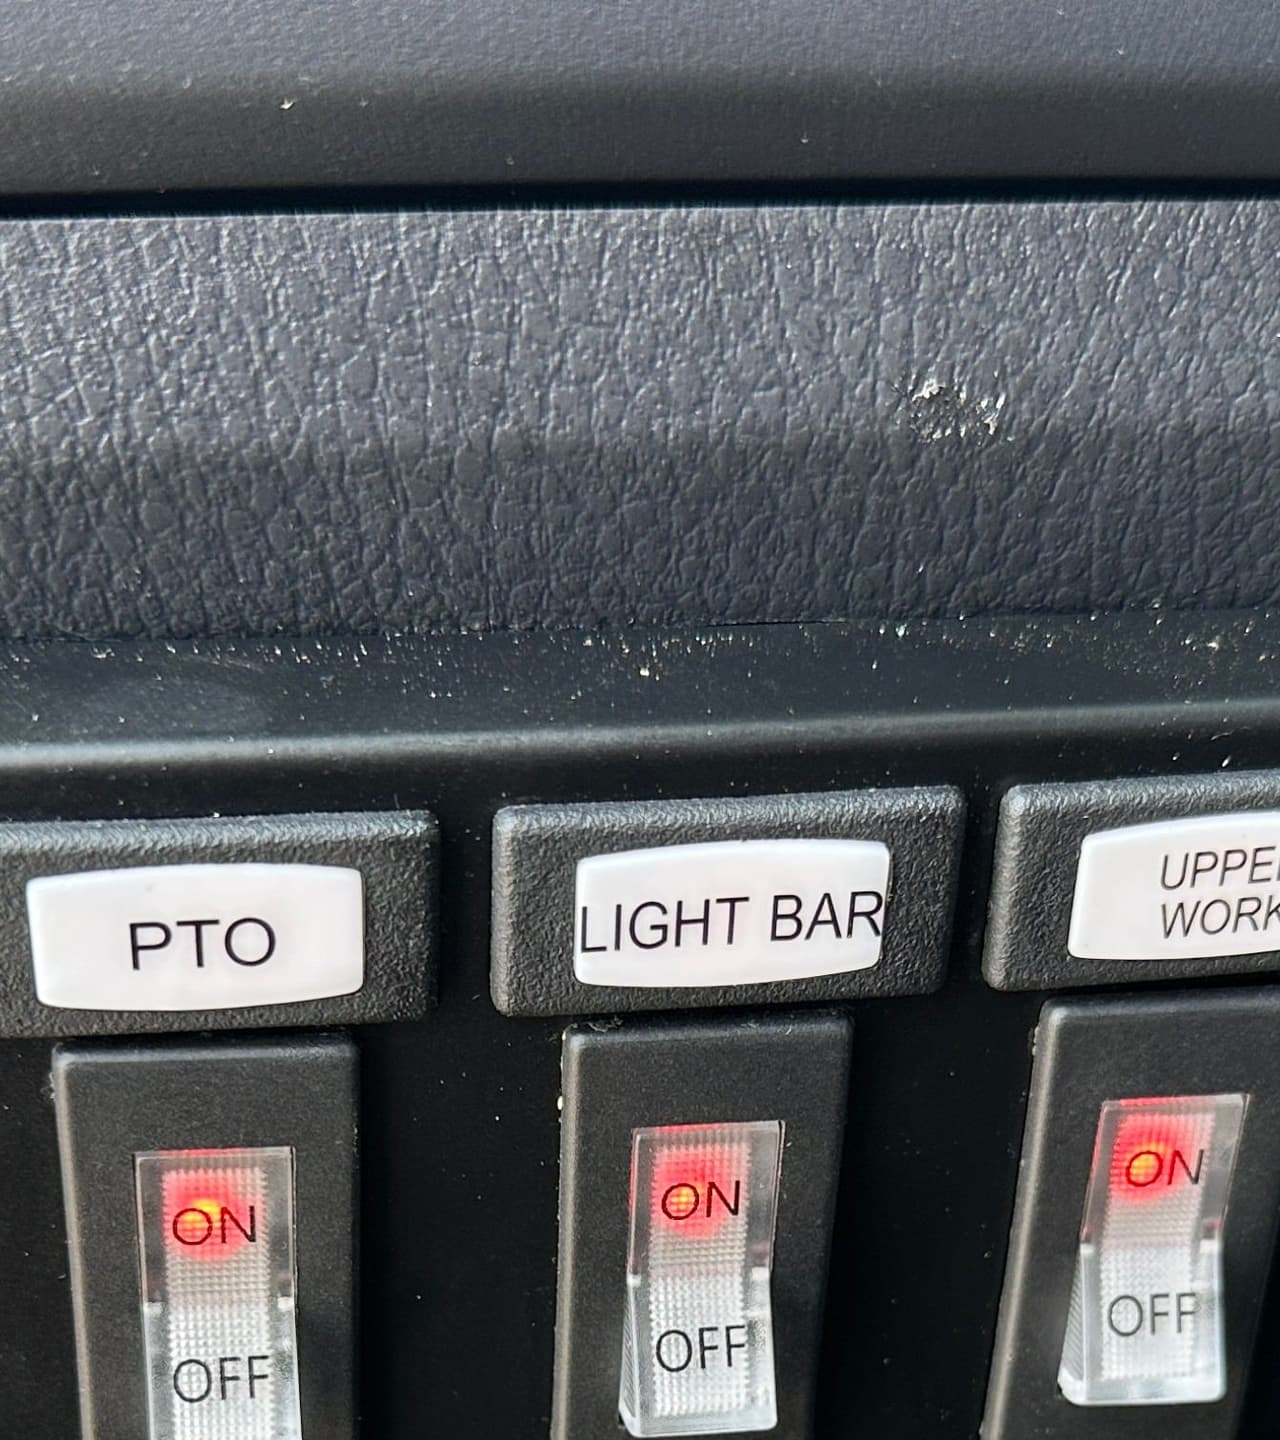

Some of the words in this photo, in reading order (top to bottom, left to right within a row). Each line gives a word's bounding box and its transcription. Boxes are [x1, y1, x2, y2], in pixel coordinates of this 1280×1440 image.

[128, 918, 278, 971] PTO
[579, 895, 755, 954] LIGHT
[769, 889, 884, 942] BAR
[1124, 1146, 1202, 1190] ON
[172, 1202, 258, 1249] ON
[661, 1179, 740, 1224] ON
[1106, 1292, 1198, 1338] OFF
[655, 1325, 748, 1374] OFF
[172, 1356, 270, 1405] OFF
